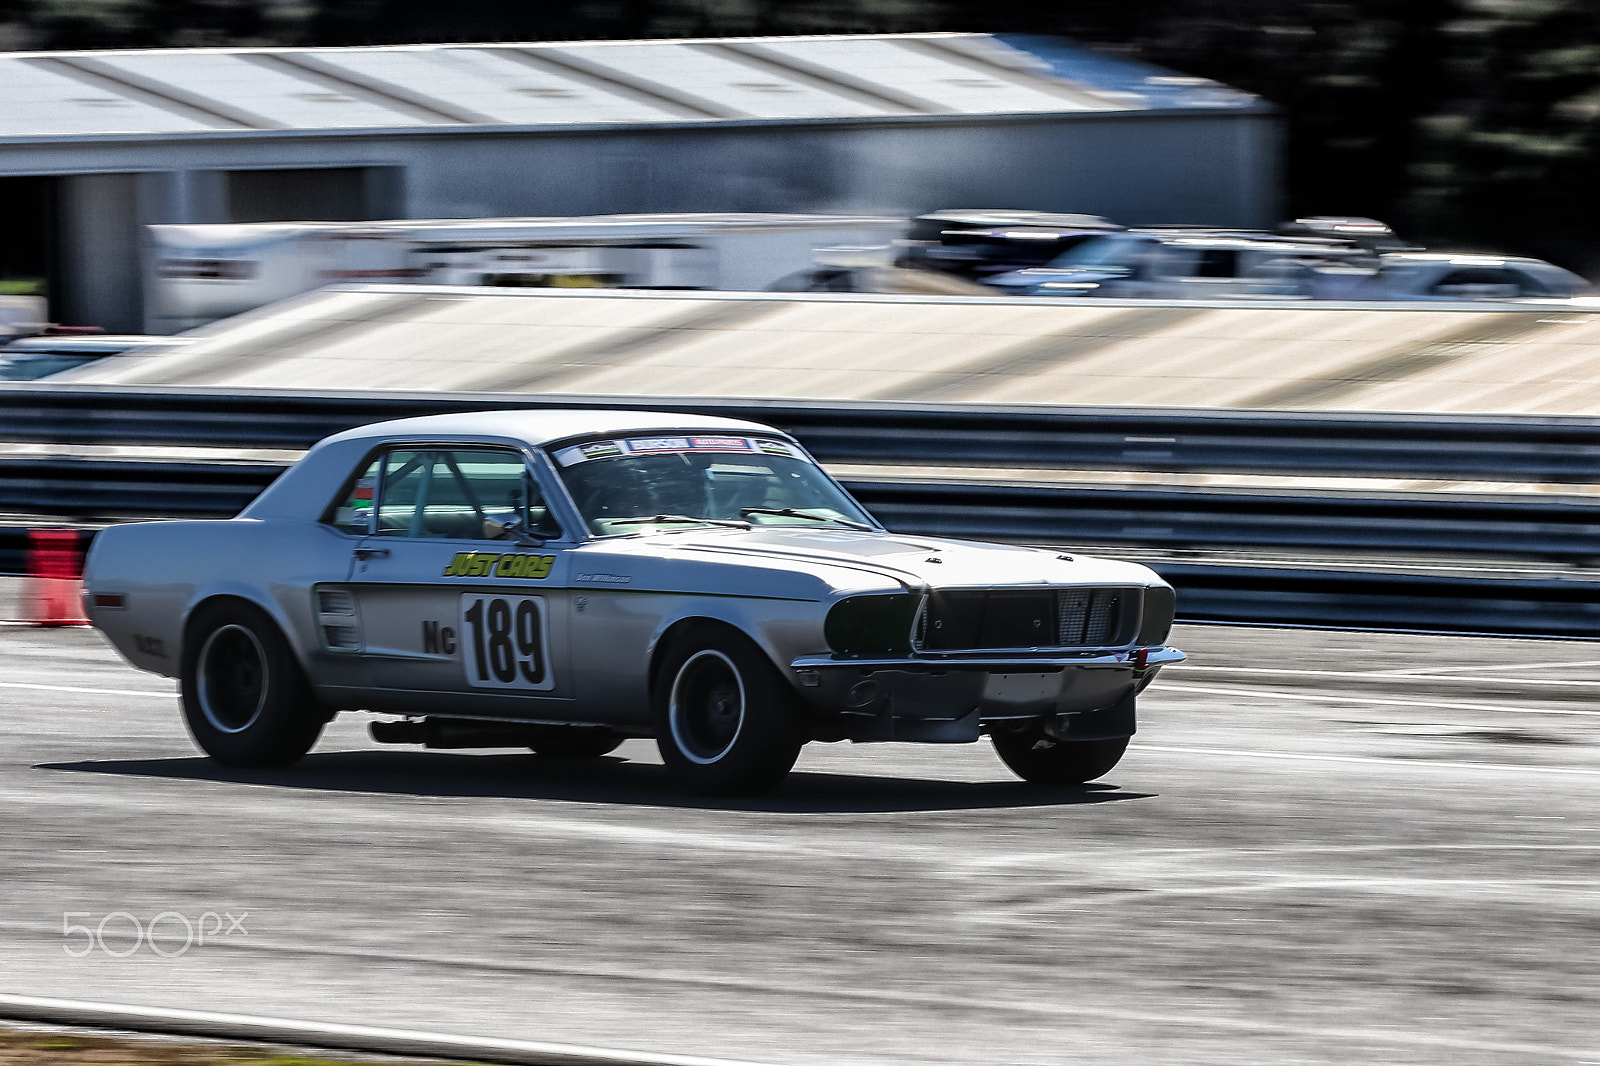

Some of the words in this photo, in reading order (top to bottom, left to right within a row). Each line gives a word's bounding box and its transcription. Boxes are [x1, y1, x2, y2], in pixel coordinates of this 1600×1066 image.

[442, 552, 500, 577] JUST
[495, 553, 556, 579] CARS
[464, 598, 546, 684] 189
